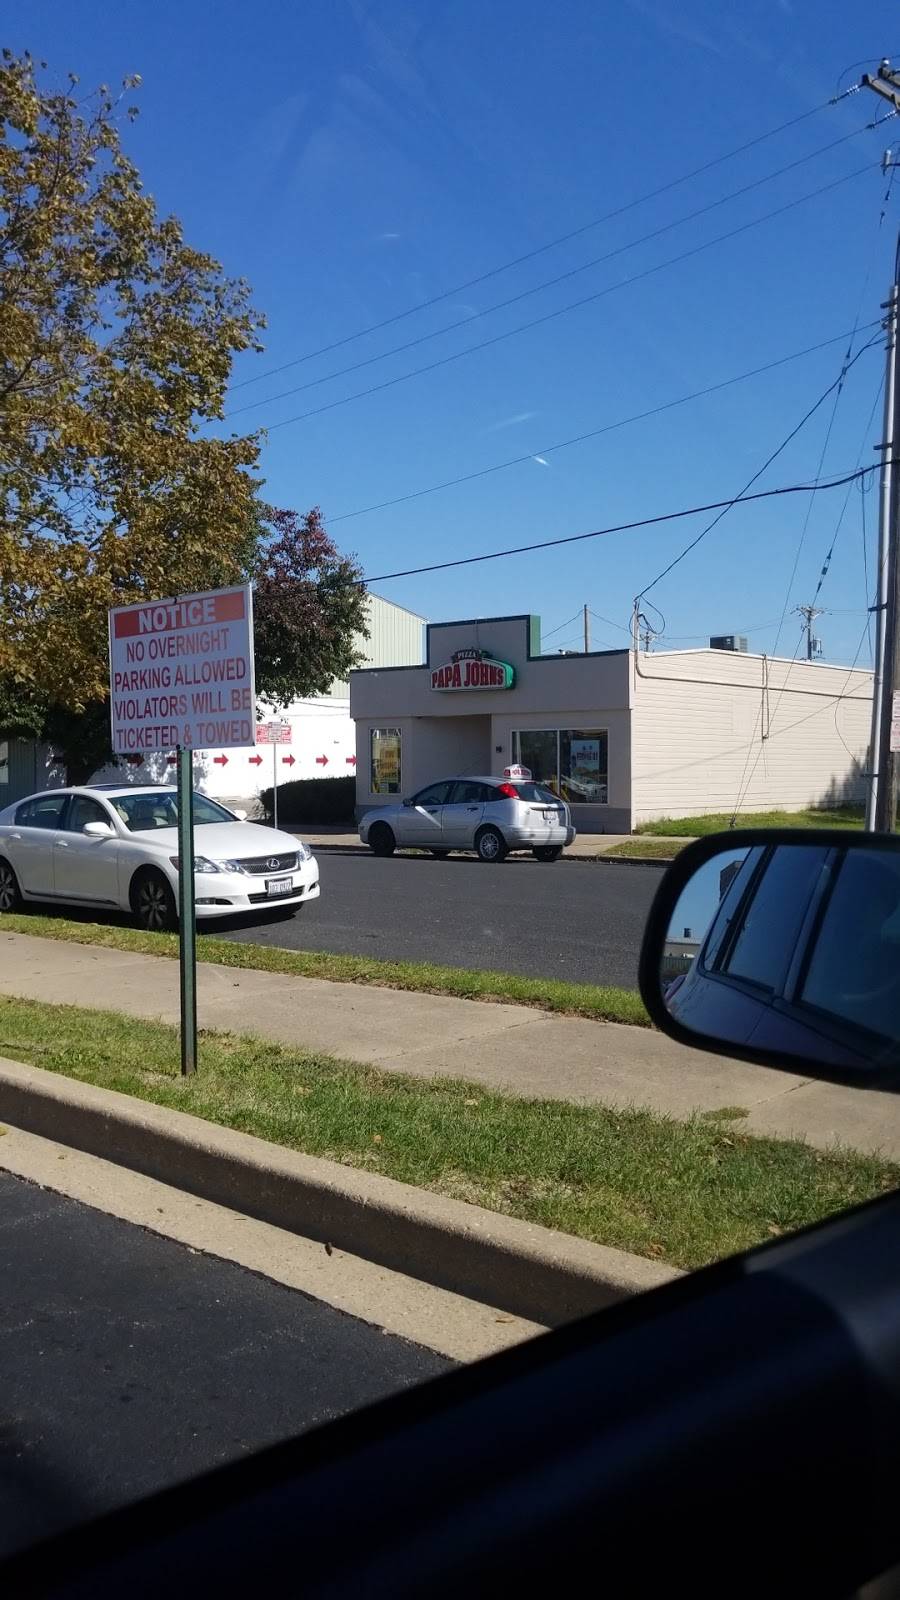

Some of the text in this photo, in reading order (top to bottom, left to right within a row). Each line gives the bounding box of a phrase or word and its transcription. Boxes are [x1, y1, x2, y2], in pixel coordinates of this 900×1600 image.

[138, 599, 216, 633] NOTICE
[126, 628, 230, 663] NO OVERNIGHT
[457, 650, 477, 659] PIZZA
[114, 657, 246, 693] PARKING ALLOWED
[431, 663, 462, 689] PAPA
[114, 687, 251, 721] VIOLATORS WILL BE
[116, 725, 179, 749] TICKETED
[183, 725, 192, 745] &
[197, 720, 251, 745] TOWED
